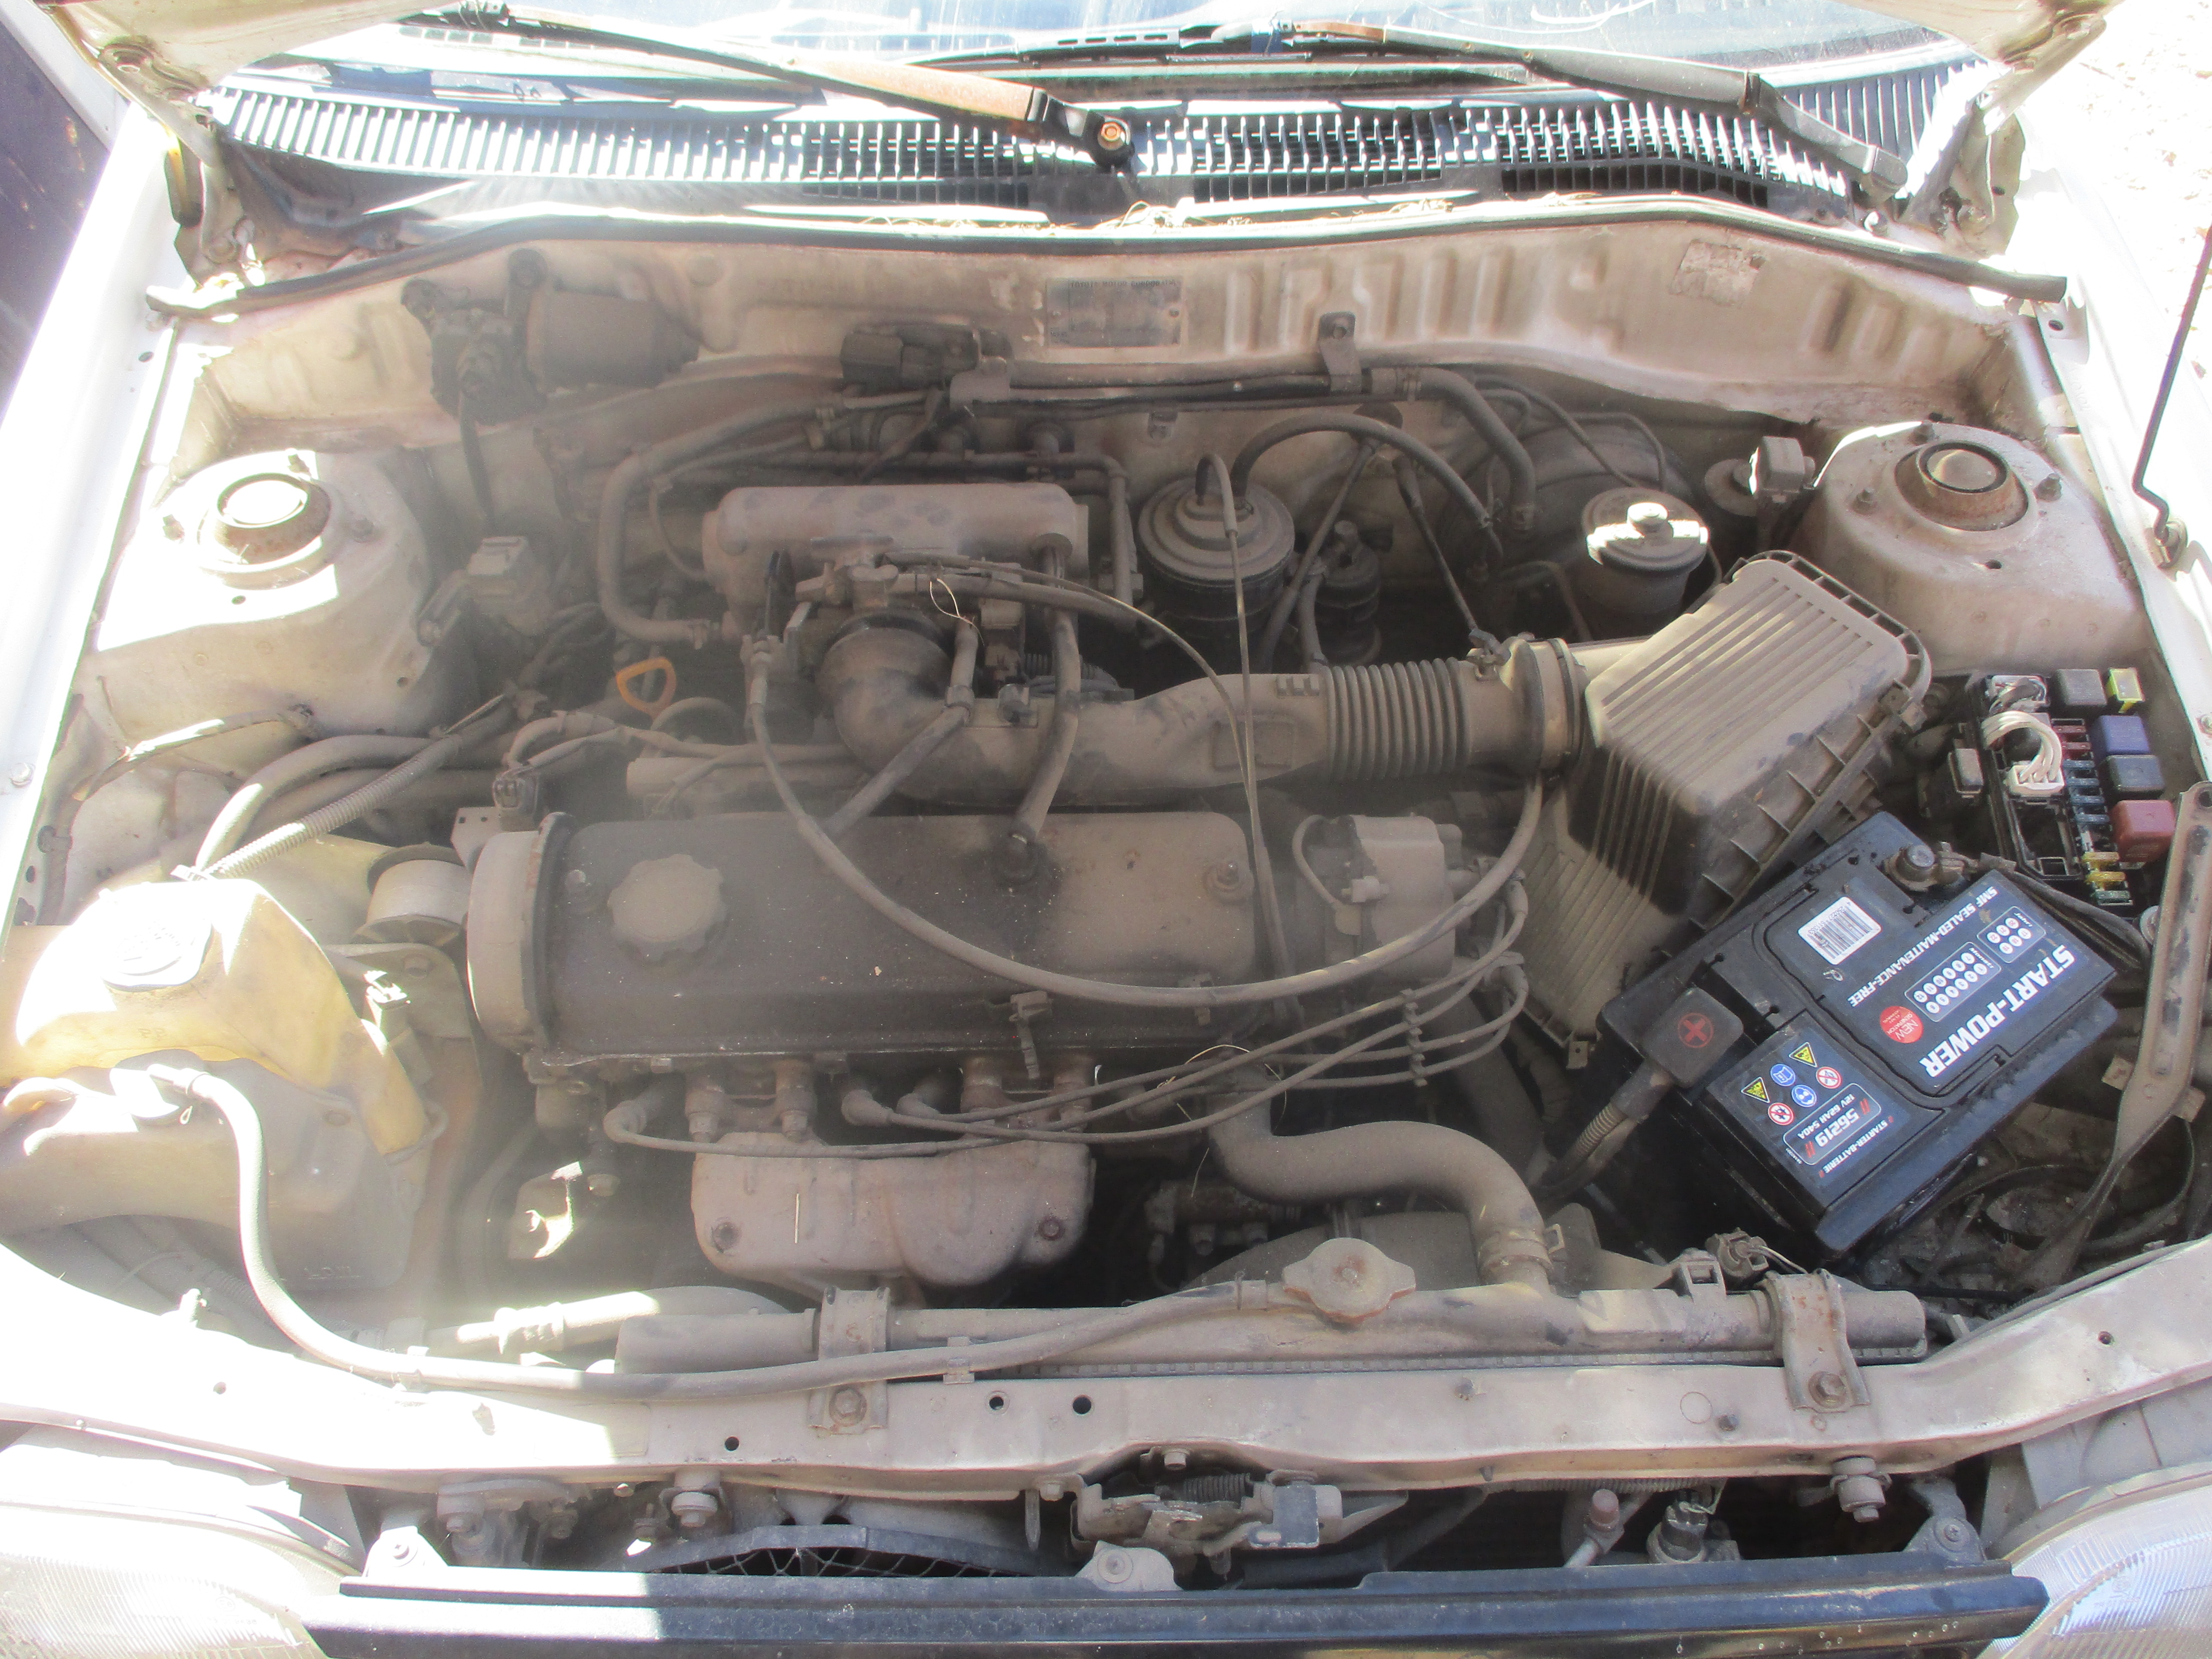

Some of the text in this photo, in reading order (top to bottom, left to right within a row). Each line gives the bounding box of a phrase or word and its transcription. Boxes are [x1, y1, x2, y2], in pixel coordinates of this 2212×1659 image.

[1847, 886, 1998, 1007] SMF SEALED-MAITENANCE-FREE
[1887, 1012, 1913, 1035] GENERATION
[1895, 1019, 1918, 1040] NEW
[1919, 945, 2075, 1077] START-POWER
[1797, 1094, 1856, 1139] 12V 62AH 540A
[1814, 1108, 1860, 1147] 56219
[1822, 1120, 1888, 1174] STARTER-BATTERIE
